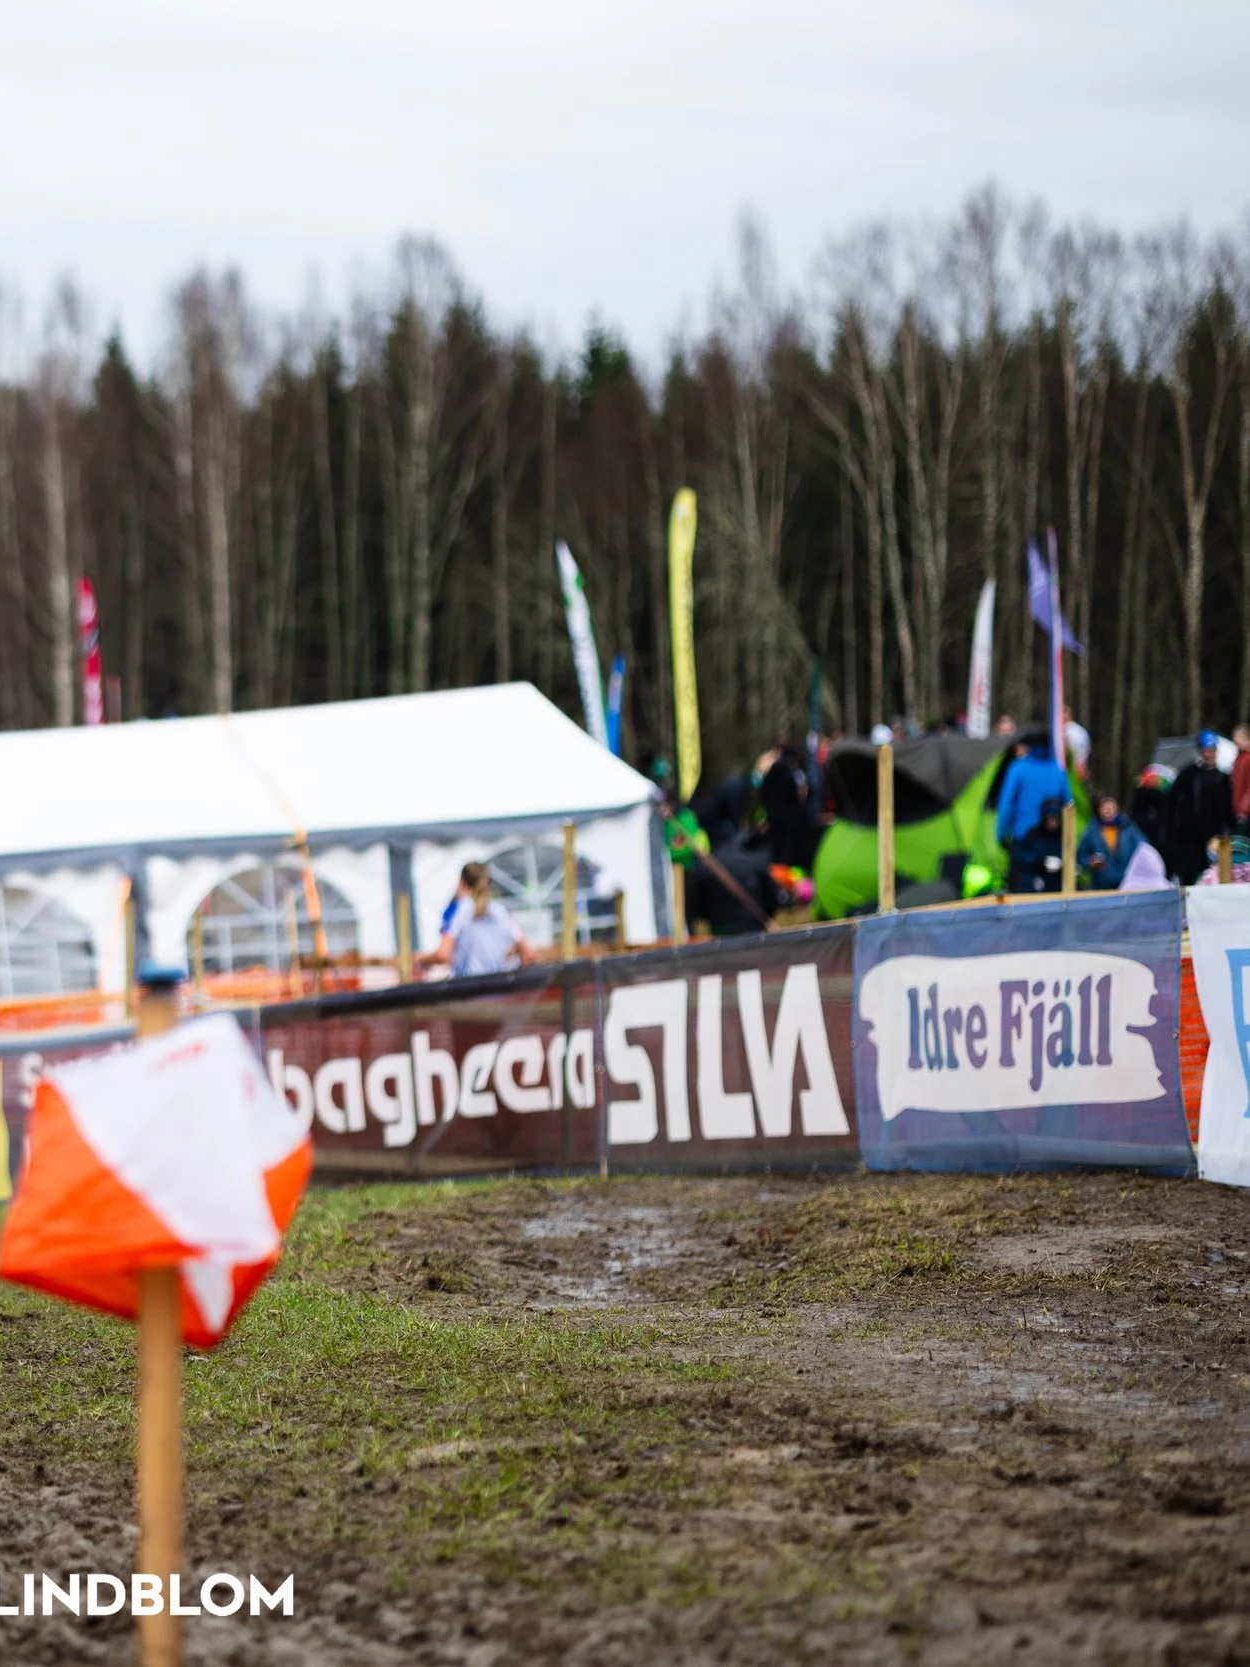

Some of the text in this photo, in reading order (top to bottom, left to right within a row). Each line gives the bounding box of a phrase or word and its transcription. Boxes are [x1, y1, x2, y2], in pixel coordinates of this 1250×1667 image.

[268, 1030, 596, 1148] bagheera
[607, 963, 851, 1146] SILVA
[906, 985, 989, 1071] Idre
[999, 973, 1114, 1093] Fjäll
